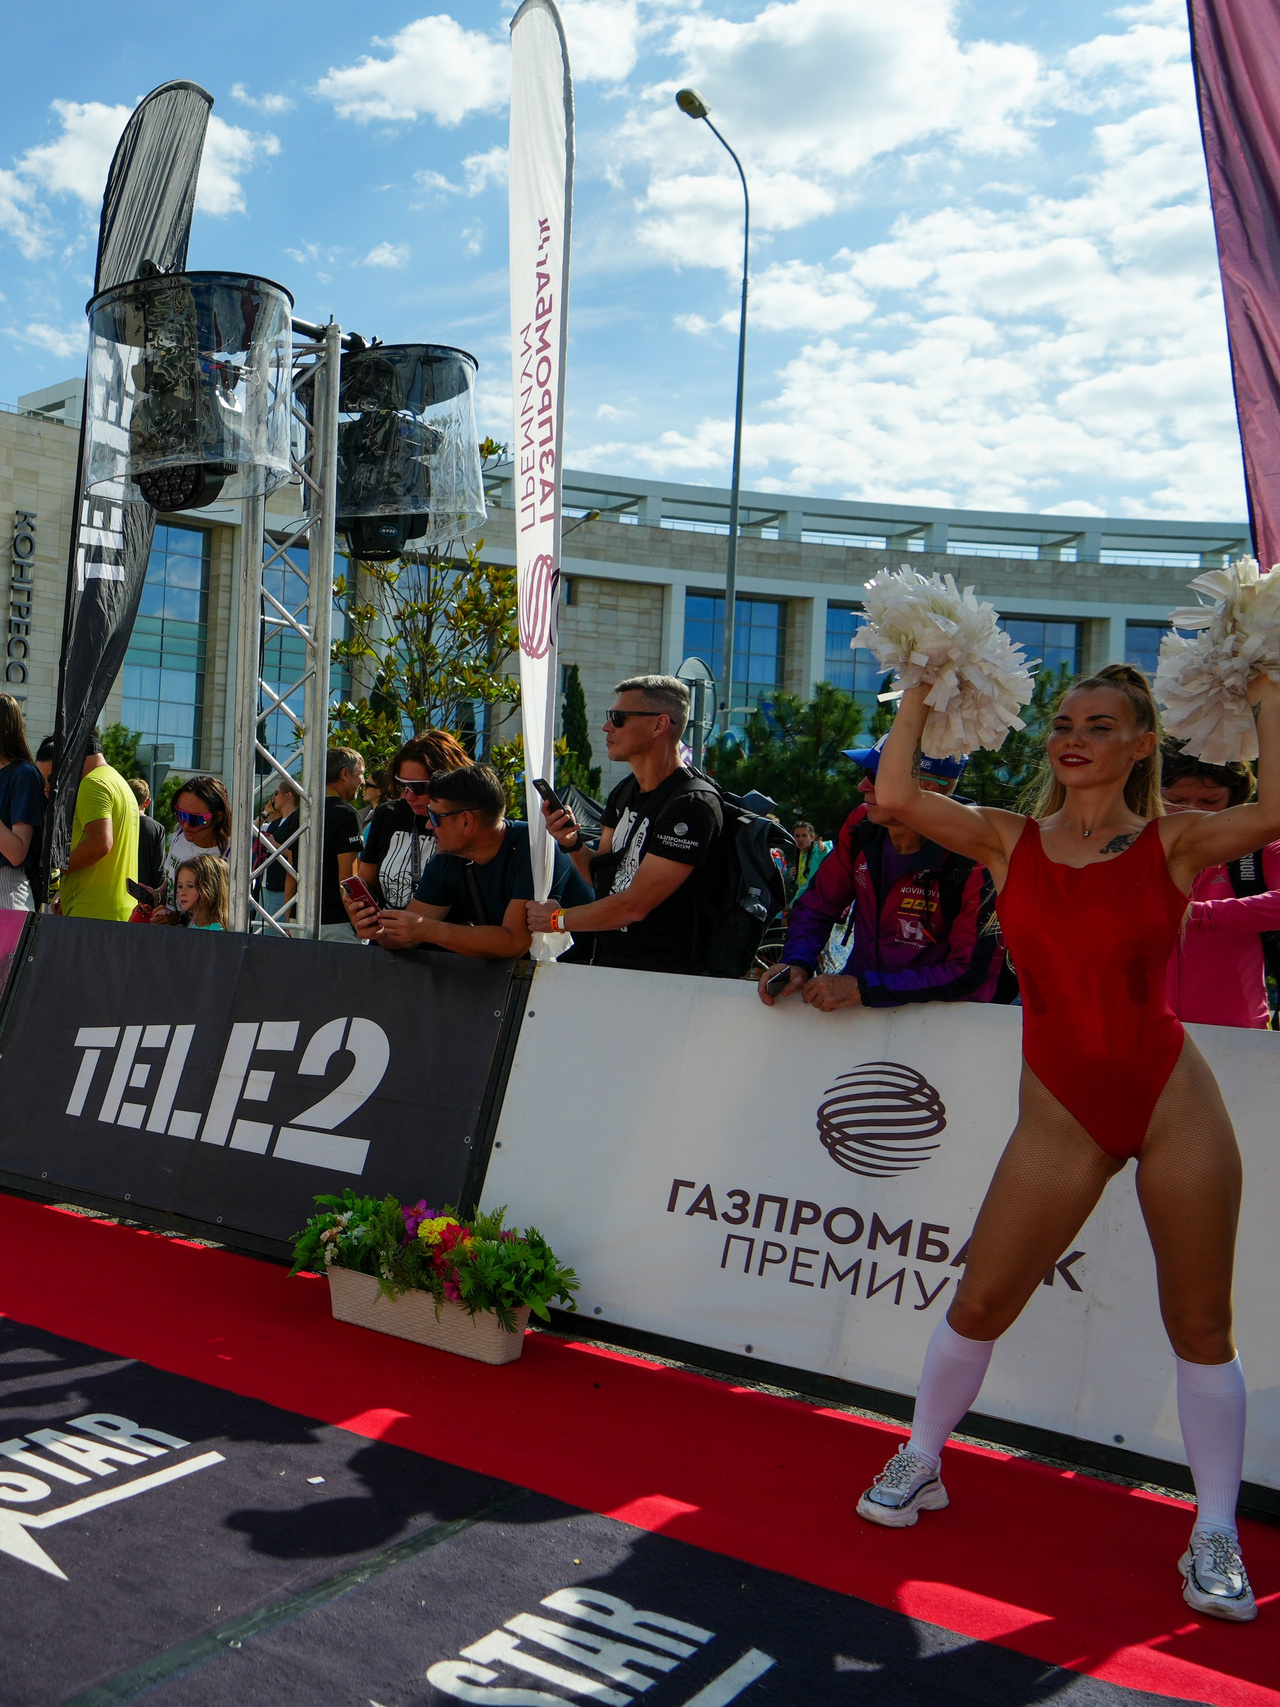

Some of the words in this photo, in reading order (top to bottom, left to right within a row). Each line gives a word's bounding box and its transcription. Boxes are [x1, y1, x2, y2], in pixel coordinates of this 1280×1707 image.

[5, 509, 38, 684] КОНГРЕСС
[1239, 852, 1256, 881] IRONS
[65, 1016, 391, 1176] TELE2
[666, 1178, 1087, 1293] ГАЗПРОМБК
[720, 1233, 962, 1311] ПРЕМИУ
[425, 1586, 717, 1707] STAR
